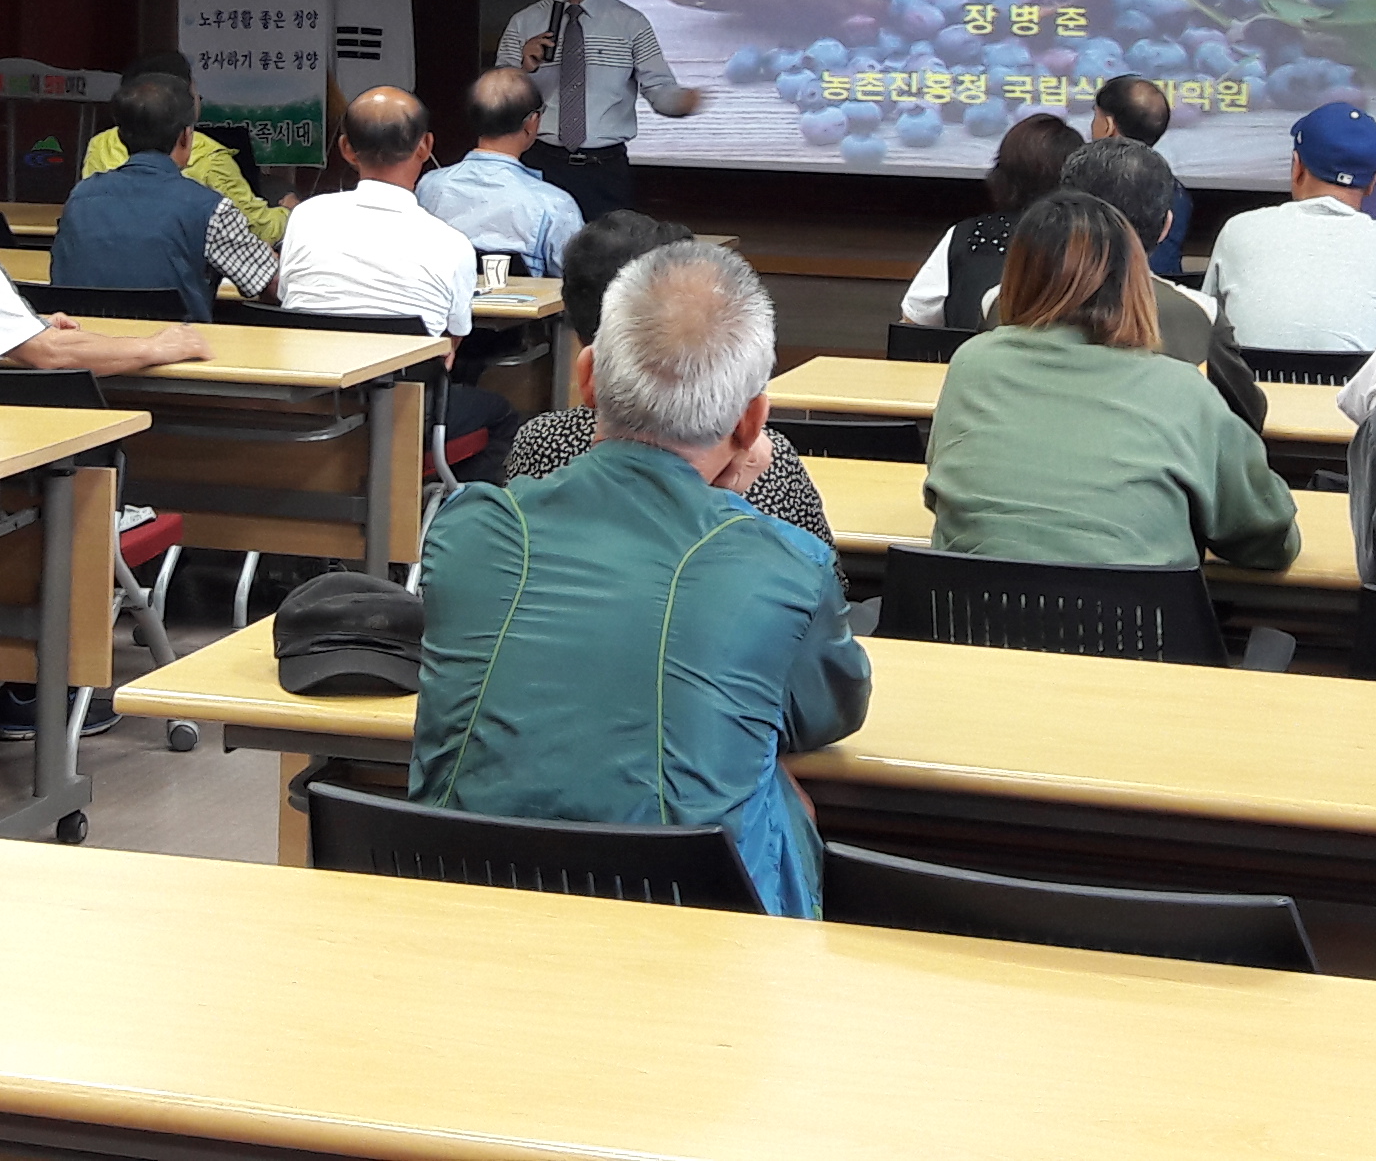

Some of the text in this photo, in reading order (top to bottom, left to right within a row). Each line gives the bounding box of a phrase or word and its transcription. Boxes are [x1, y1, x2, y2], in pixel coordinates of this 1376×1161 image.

[198, 10, 319, 30] 노후생활 좋은 청양
[199, 51, 319, 70] 장사하기 좋은 청양
[821, 70, 1250, 113] 농촌진흥청 국립식학원
